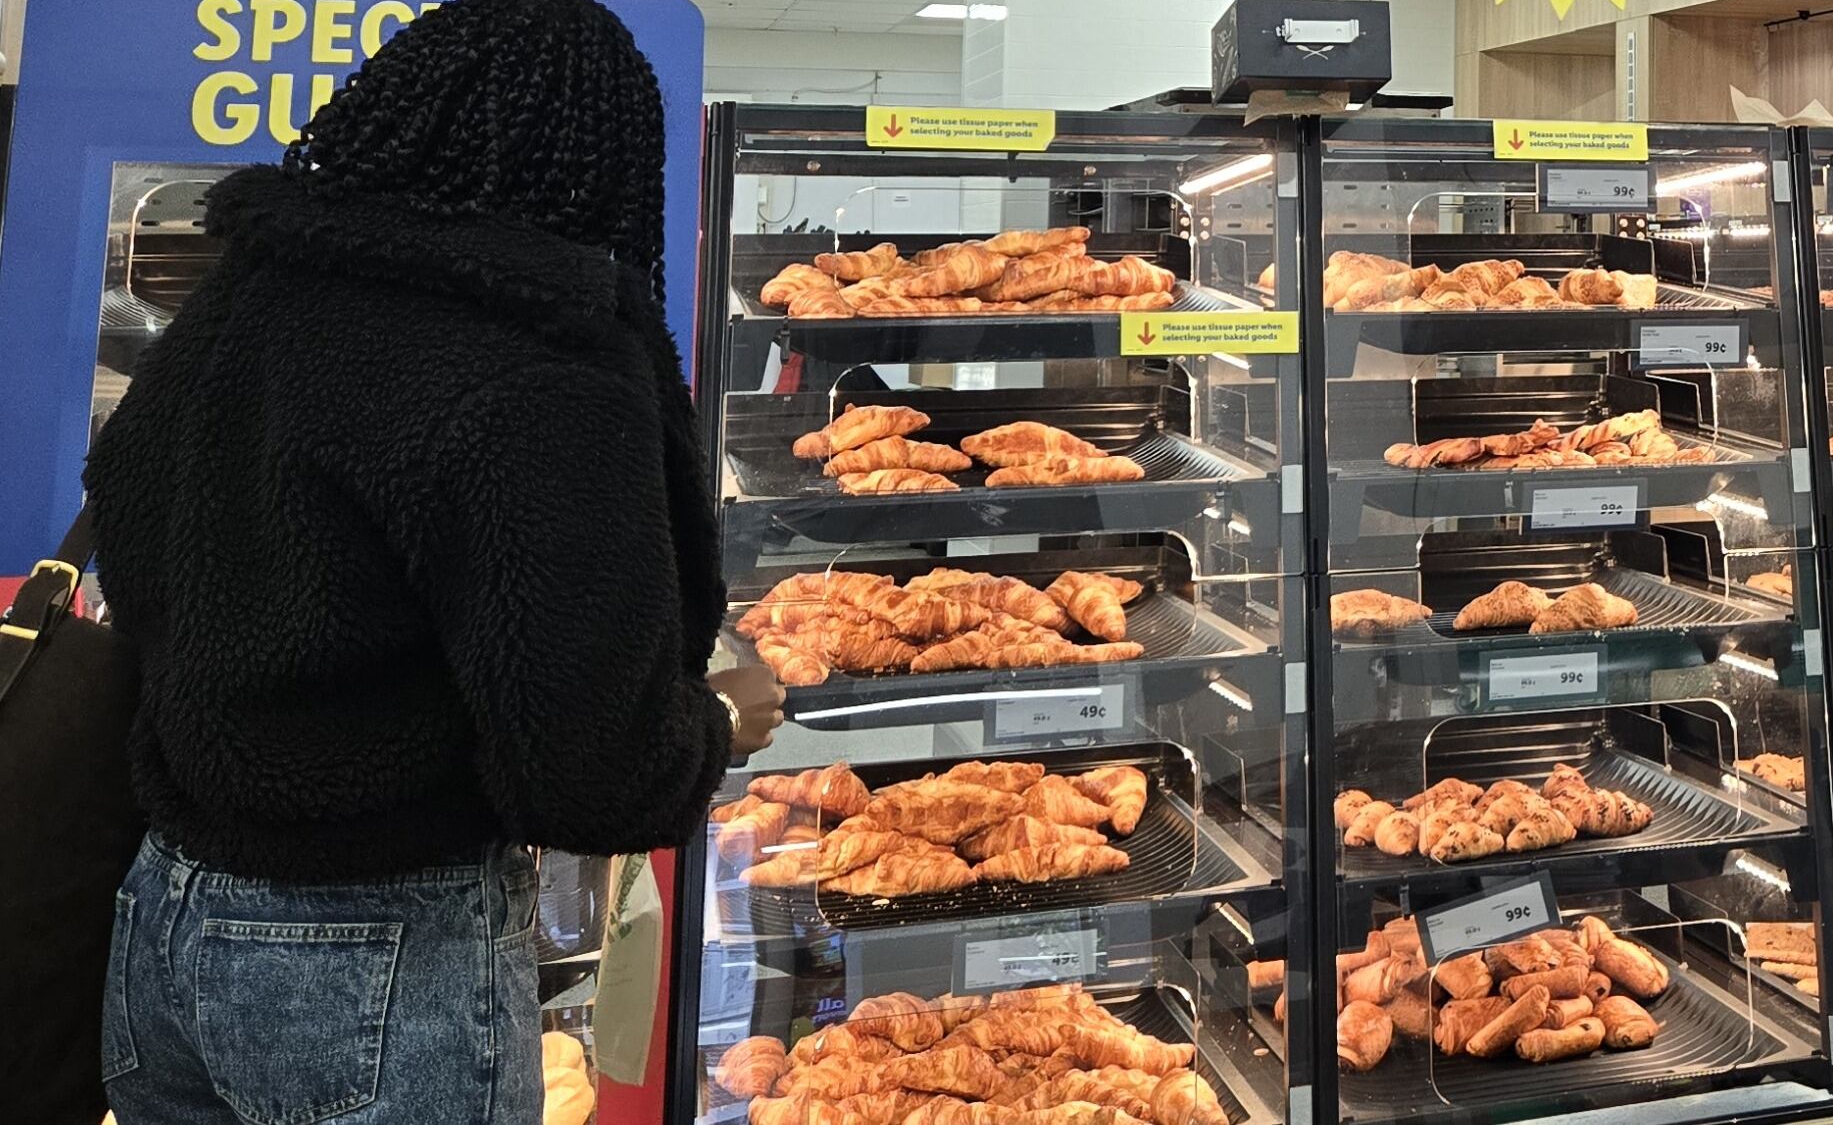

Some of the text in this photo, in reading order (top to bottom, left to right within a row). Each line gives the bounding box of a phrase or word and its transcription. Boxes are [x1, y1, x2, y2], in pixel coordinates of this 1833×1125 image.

[910, 116, 940, 125] Please
[959, 117, 986, 126] tissue
[987, 120, 1013, 129] paper
[1014, 120, 1038, 128] when
[910, 126, 1033, 139] selecting your baked goods
[1569, 131, 1590, 139] tissue
[1529, 140, 1564, 149] selecting
[1583, 141, 1605, 149] baked
[1606, 142, 1630, 150] goods
[1613, 186, 1635, 198] 99¢
[1162, 323, 1190, 331] Please
[1208, 323, 1233, 331] tissue
[1235, 324, 1259, 333] paper
[1261, 323, 1283, 331] when
[1162, 332, 1278, 342] selecting your baked goods
[1705, 341, 1726, 353] 99¢
[1560, 672, 1584, 684] 99¢
[1080, 705, 1106, 718] 49¢
[1505, 905, 1531, 922] 99¢
